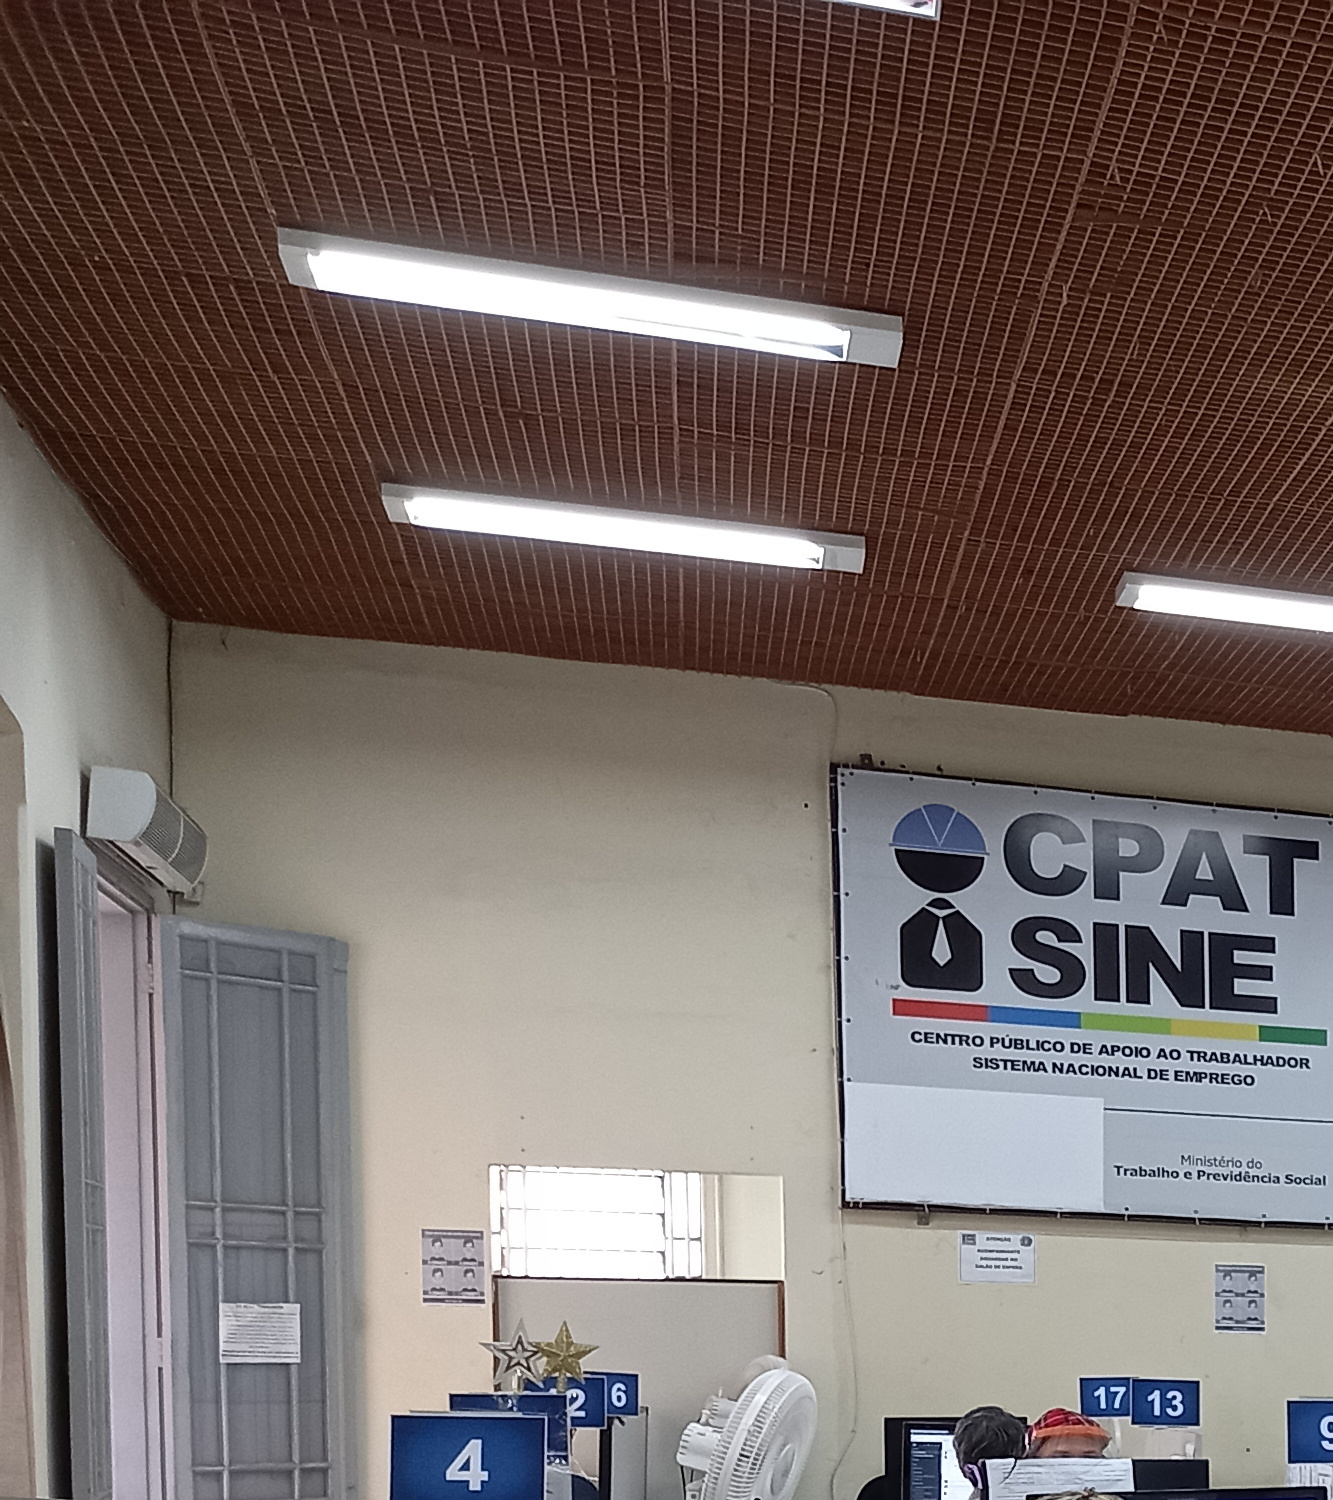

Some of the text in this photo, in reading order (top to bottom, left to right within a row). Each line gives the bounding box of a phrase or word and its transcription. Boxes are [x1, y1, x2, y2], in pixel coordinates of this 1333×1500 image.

[1003, 811, 1320, 917] CPAT
[1008, 916, 1278, 1015] SINE
[910, 1030, 1311, 1070] CENTRO PÚBLICO DE APOIO AO TRABALHADOR
[972, 1055, 1257, 1087] SISTEMA NACIONAL DE EMPREGO
[1113, 1164, 1328, 1187] Trabalho e Previdência Social
[1180, 1154, 1263, 1170] Ministério do
[1093, 1386, 1127, 1411] 17
[1145, 1388, 1184, 1417] 13
[445, 1438, 489, 1491] 4
